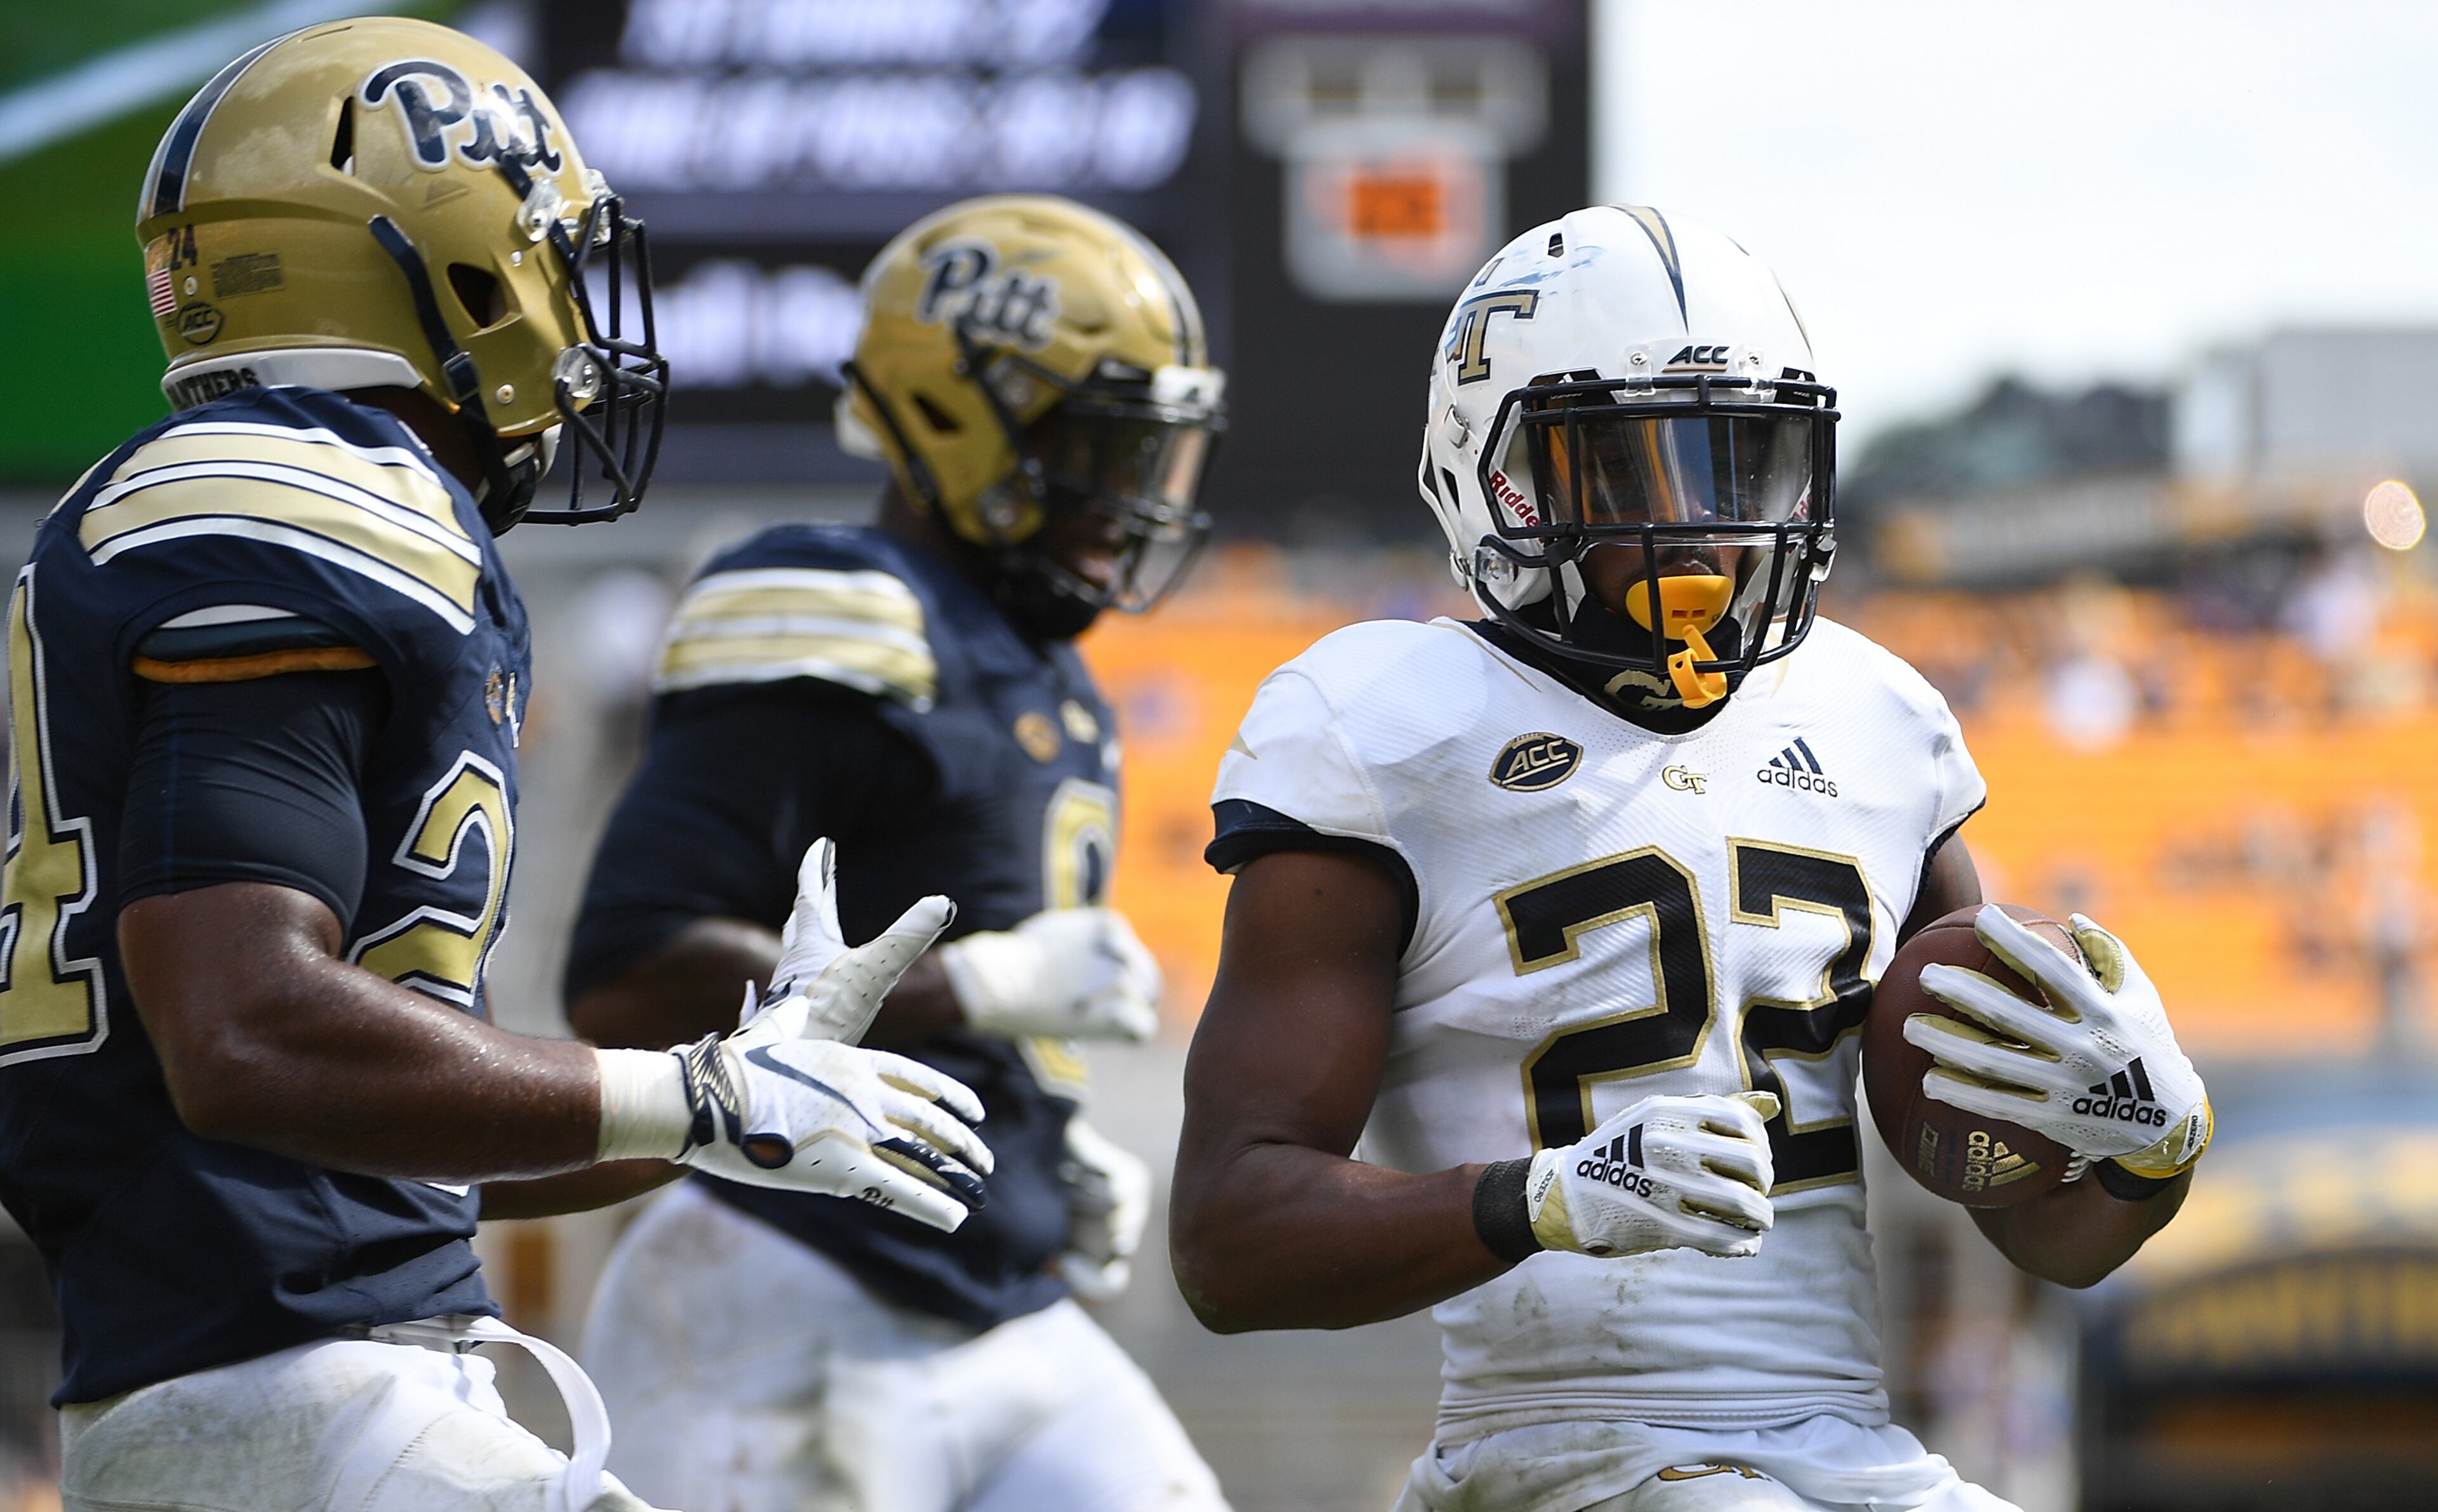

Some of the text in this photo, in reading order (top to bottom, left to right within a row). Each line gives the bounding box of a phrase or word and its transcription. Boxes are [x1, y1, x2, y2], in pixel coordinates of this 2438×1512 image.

[358, 58, 564, 175] Pitt
[917, 239, 1059, 350] Pitt
[182, 308, 215, 331] ACC
[1667, 345, 1730, 364] ACC
[1489, 470, 1545, 545] Ridde
[1505, 739, 1569, 779] ACC
[1662, 765, 1708, 795] GT
[1757, 767, 1839, 798] adidas
[1493, 835, 1879, 1198] 22
[2072, 1089, 2167, 1127] adidas
[1576, 1158, 1652, 1198] adidas
[1962, 1130, 1995, 1192] adidas
